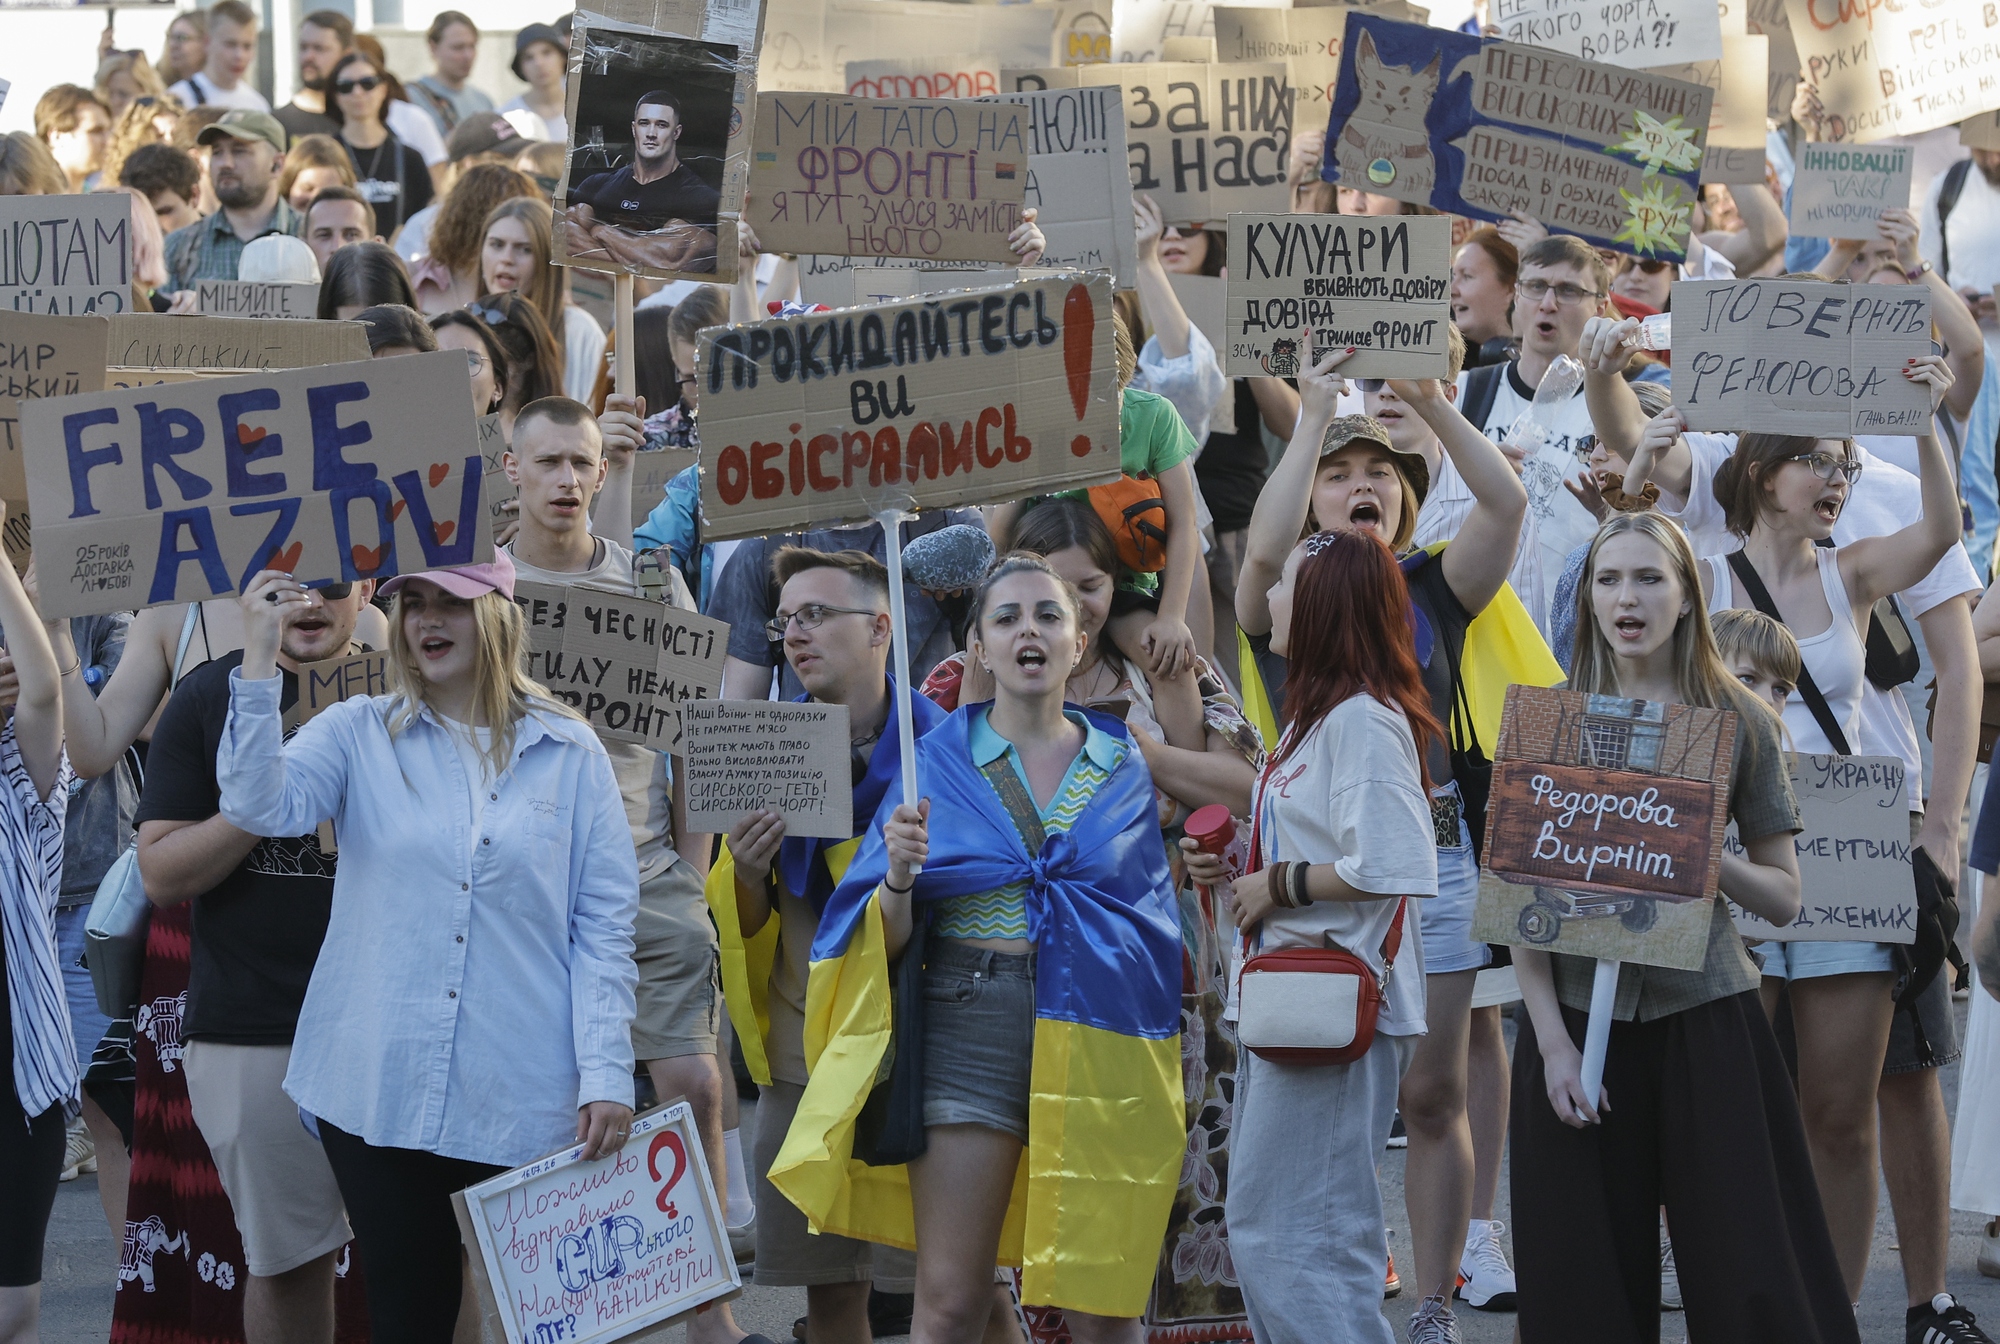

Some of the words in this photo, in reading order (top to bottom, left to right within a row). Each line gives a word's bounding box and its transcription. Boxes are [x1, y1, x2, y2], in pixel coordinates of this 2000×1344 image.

[872, 105, 959, 149] ТАТО
[976, 110, 1025, 154] НА
[1470, 131, 1630, 188] ПРИЗНАЧЕННЯ
[1467, 162, 1531, 193] ПОСАД
[1542, 177, 1553, 195] В
[770, 191, 789, 223] Я
[791, 190, 853, 225] ТУТ
[857, 194, 937, 228] ЗЛЮСЯ
[1465, 183, 1530, 213] ЗАКОНУ
[847, 224, 943, 256] НЬОГО
[1246, 221, 1409, 280] КУЛУАРИ
[200, 283, 292, 313] МІНЯЙТЕ
[1303, 276, 1389, 297] ВБИВАЮТЬ
[708, 287, 1058, 394] ПРОКИДАЙТЕСЬ
[1372, 319, 1439, 350] ФРОНТ
[1688, 351, 1887, 404] ФЕДОРОВА
[850, 375, 916, 426] ВИ
[62, 381, 379, 519] FREE
[147, 455, 482, 605] AZOV
[70, 559, 135, 583] ДОСТАВКА
[76, 543, 98, 565] 25
[779, 740, 810, 751] ПРАВО
[689, 782, 772, 798] СИРСЬКОГО
[689, 795, 765, 812] СИРСЬКИЙ
[1531, 774, 1679, 832] Федорова
[1532, 820, 1675, 881] Вирніт.
[1795, 836, 1913, 865] МЕРТВИХ
[493, 1150, 639, 1232] Можливо
